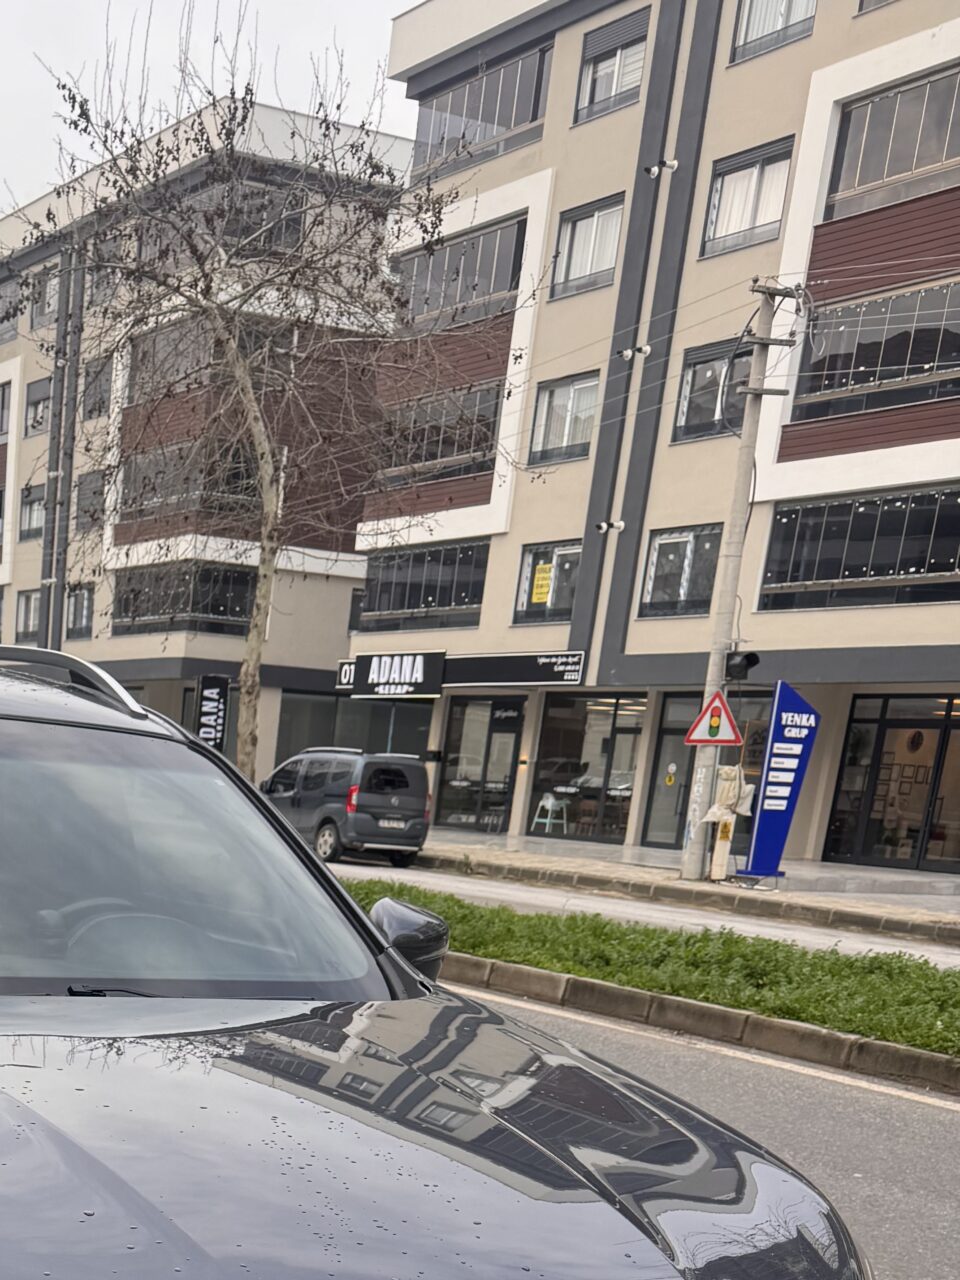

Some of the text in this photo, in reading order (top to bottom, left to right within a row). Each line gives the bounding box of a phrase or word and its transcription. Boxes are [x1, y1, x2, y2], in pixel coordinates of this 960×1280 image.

[341, 664, 356, 685] 01
[368, 655, 424, 684] ADANA
[781, 712, 816, 727] YENKA
[784, 727, 809, 738] GRUP
